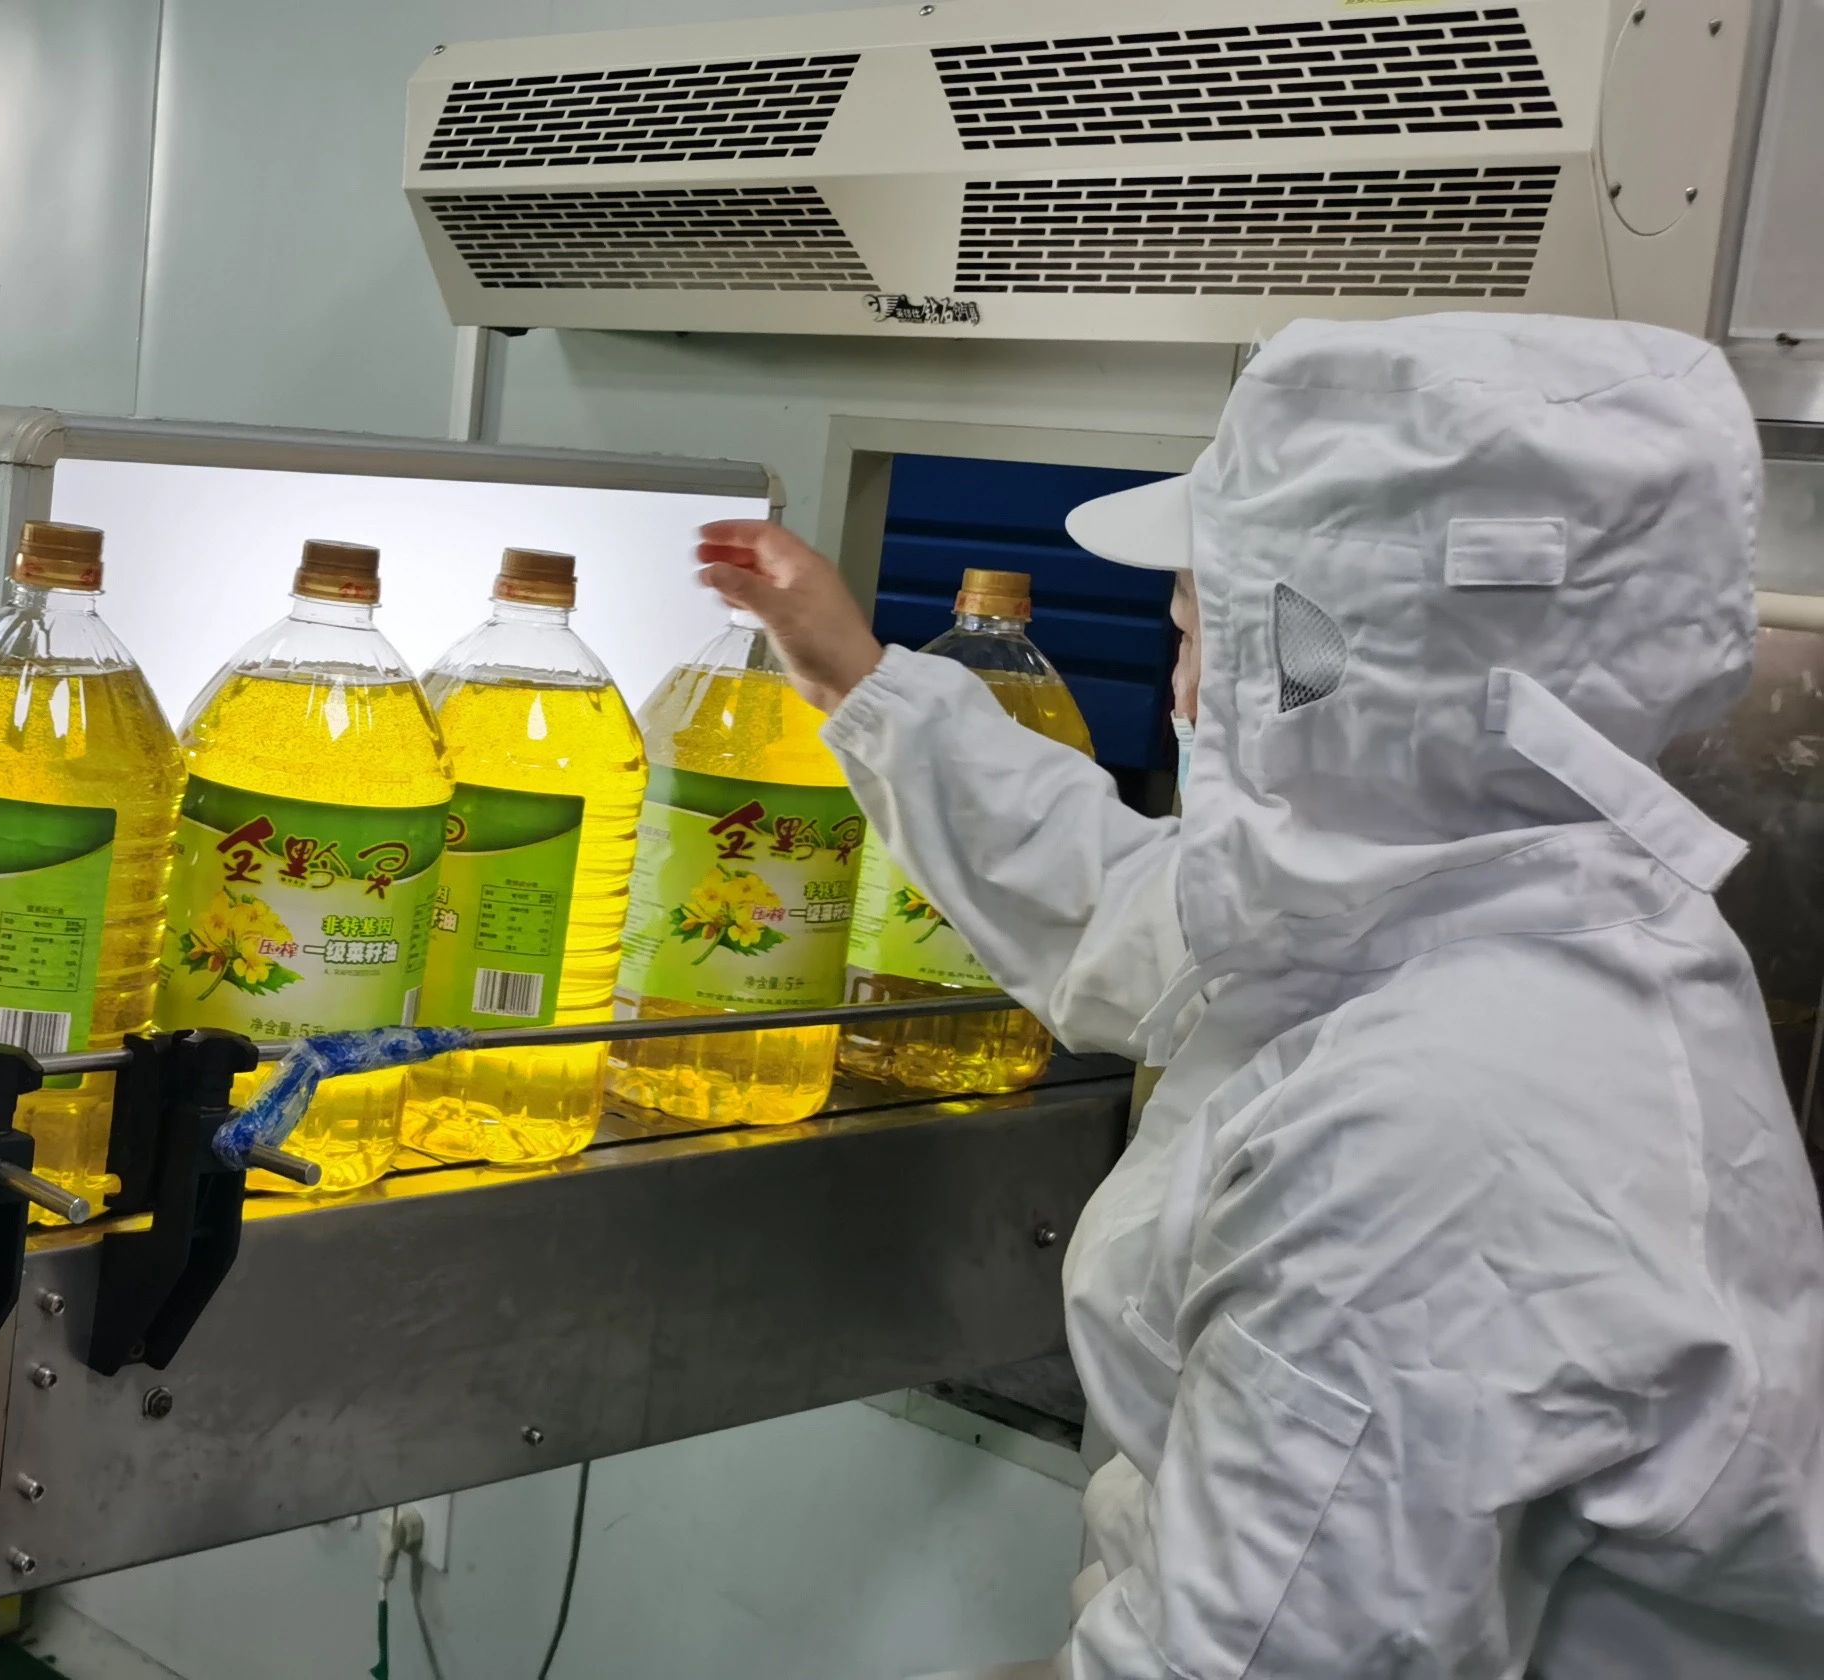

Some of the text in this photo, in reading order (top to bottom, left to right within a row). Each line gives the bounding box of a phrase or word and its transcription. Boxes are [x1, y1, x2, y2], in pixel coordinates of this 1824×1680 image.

[321, 914, 395, 937] 非转基因
[258, 938, 399, 964] 压榨 一级菜籽油
